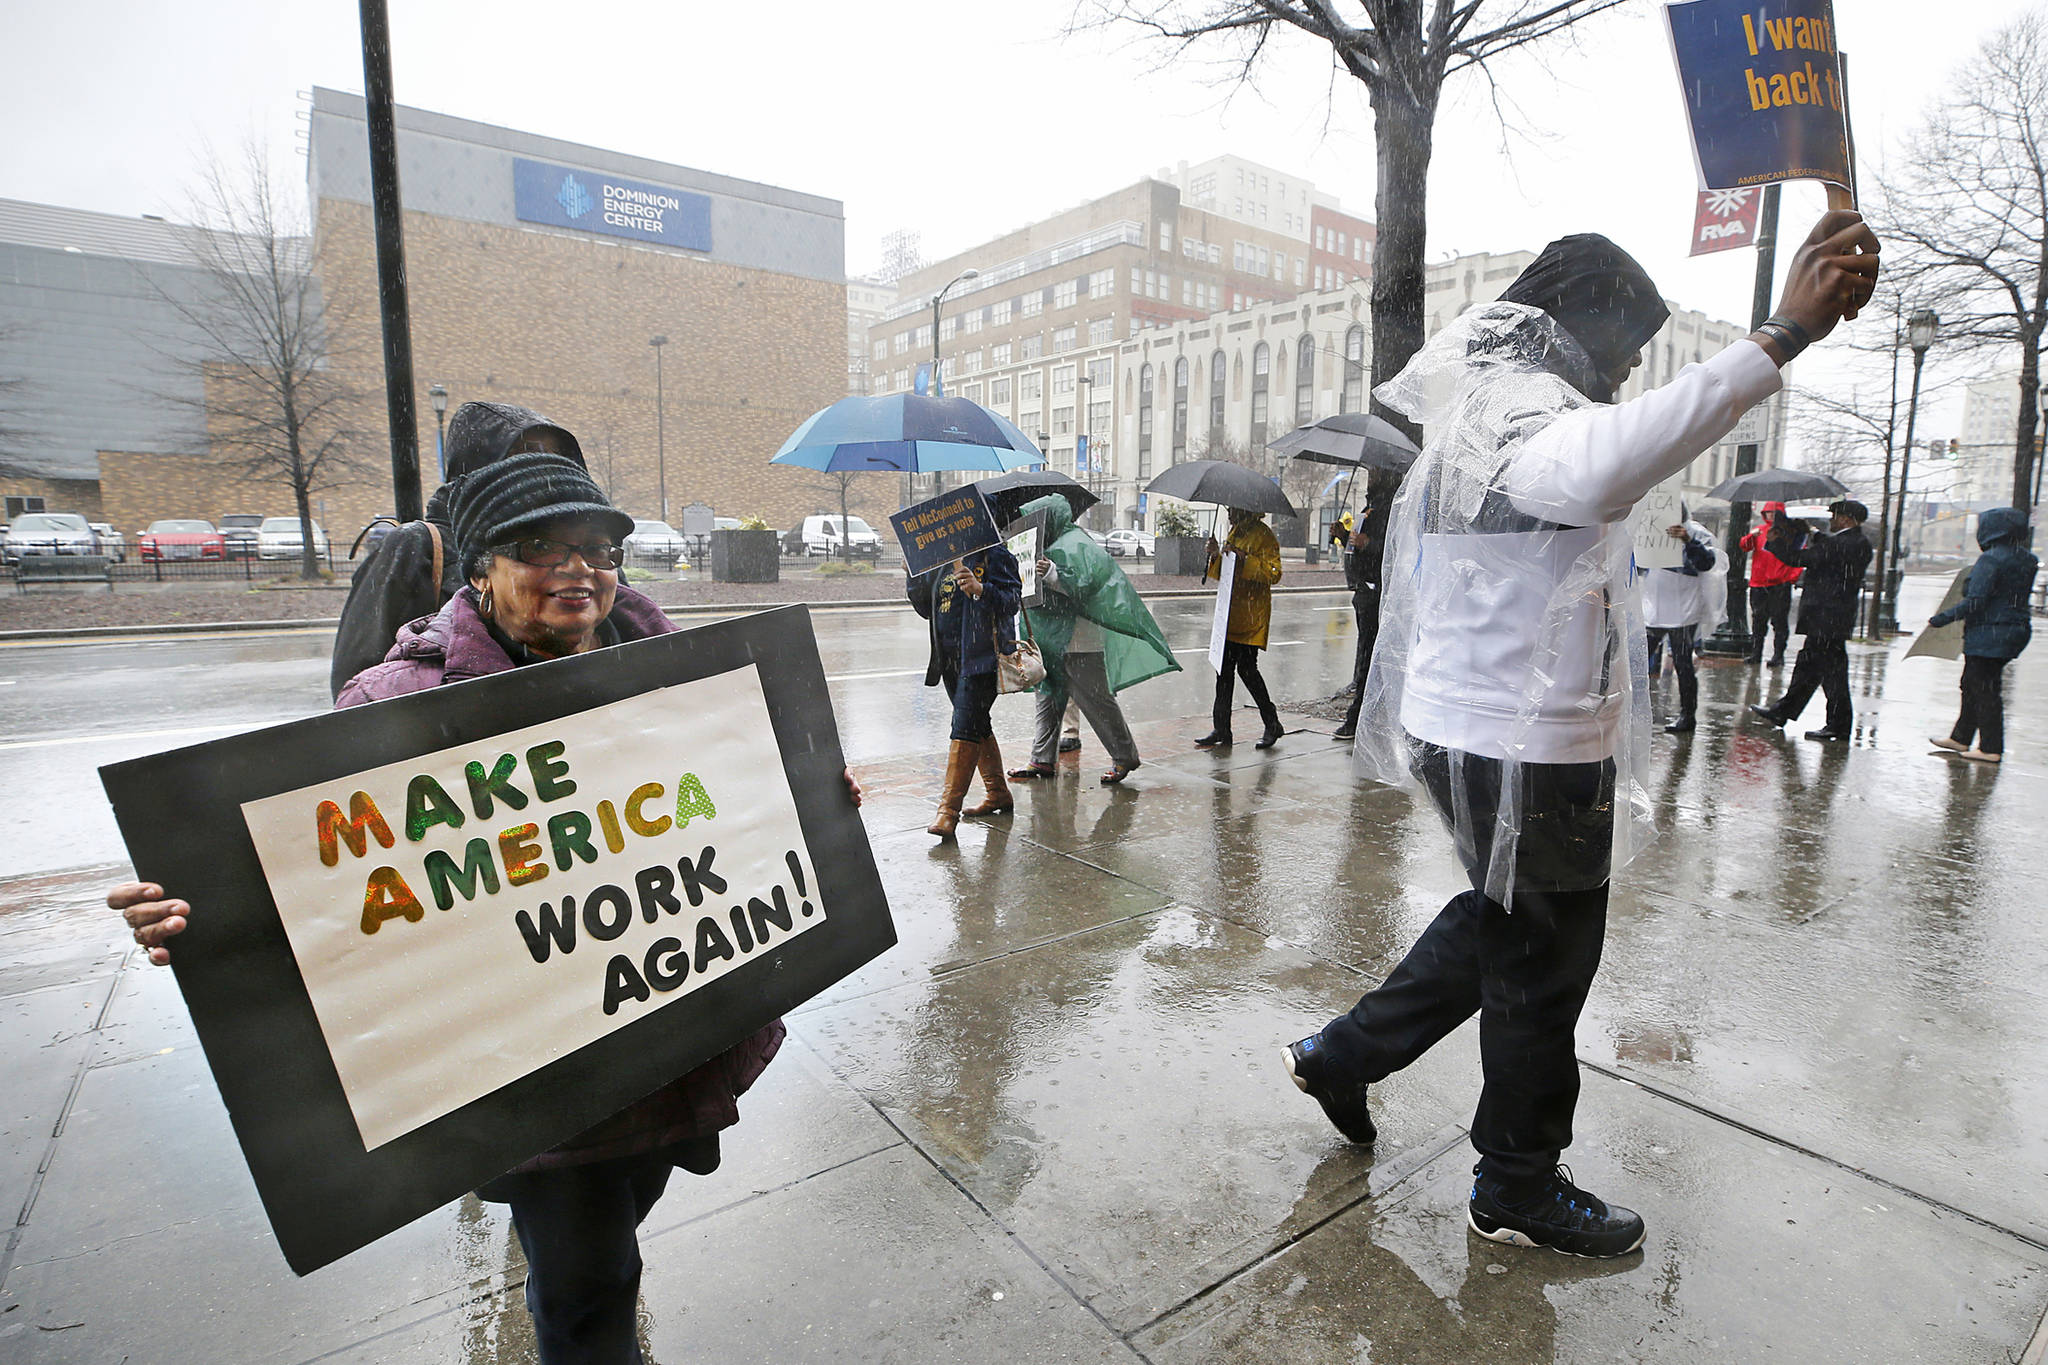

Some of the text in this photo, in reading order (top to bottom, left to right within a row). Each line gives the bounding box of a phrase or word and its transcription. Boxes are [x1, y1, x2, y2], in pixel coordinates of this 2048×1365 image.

[1742, 14, 1834, 57] I want
[1744, 61, 1824, 111] back
[1737, 170, 1786, 185] AMERICAN
[603, 184, 679, 210] DOMINION
[603, 199, 664, 220] ENERGY
[603, 212, 664, 234] CENTER
[1700, 219, 1746, 242] RVA
[901, 497, 975, 534] Tell McConnell to
[915, 532, 936, 550] give
[935, 526, 947, 538] us
[954, 514, 975, 530] vote
[316, 740, 577, 867] MAKE
[360, 772, 717, 934] AMERICA
[515, 845, 728, 964] WORK
[602, 850, 815, 1015] AGAIN!
